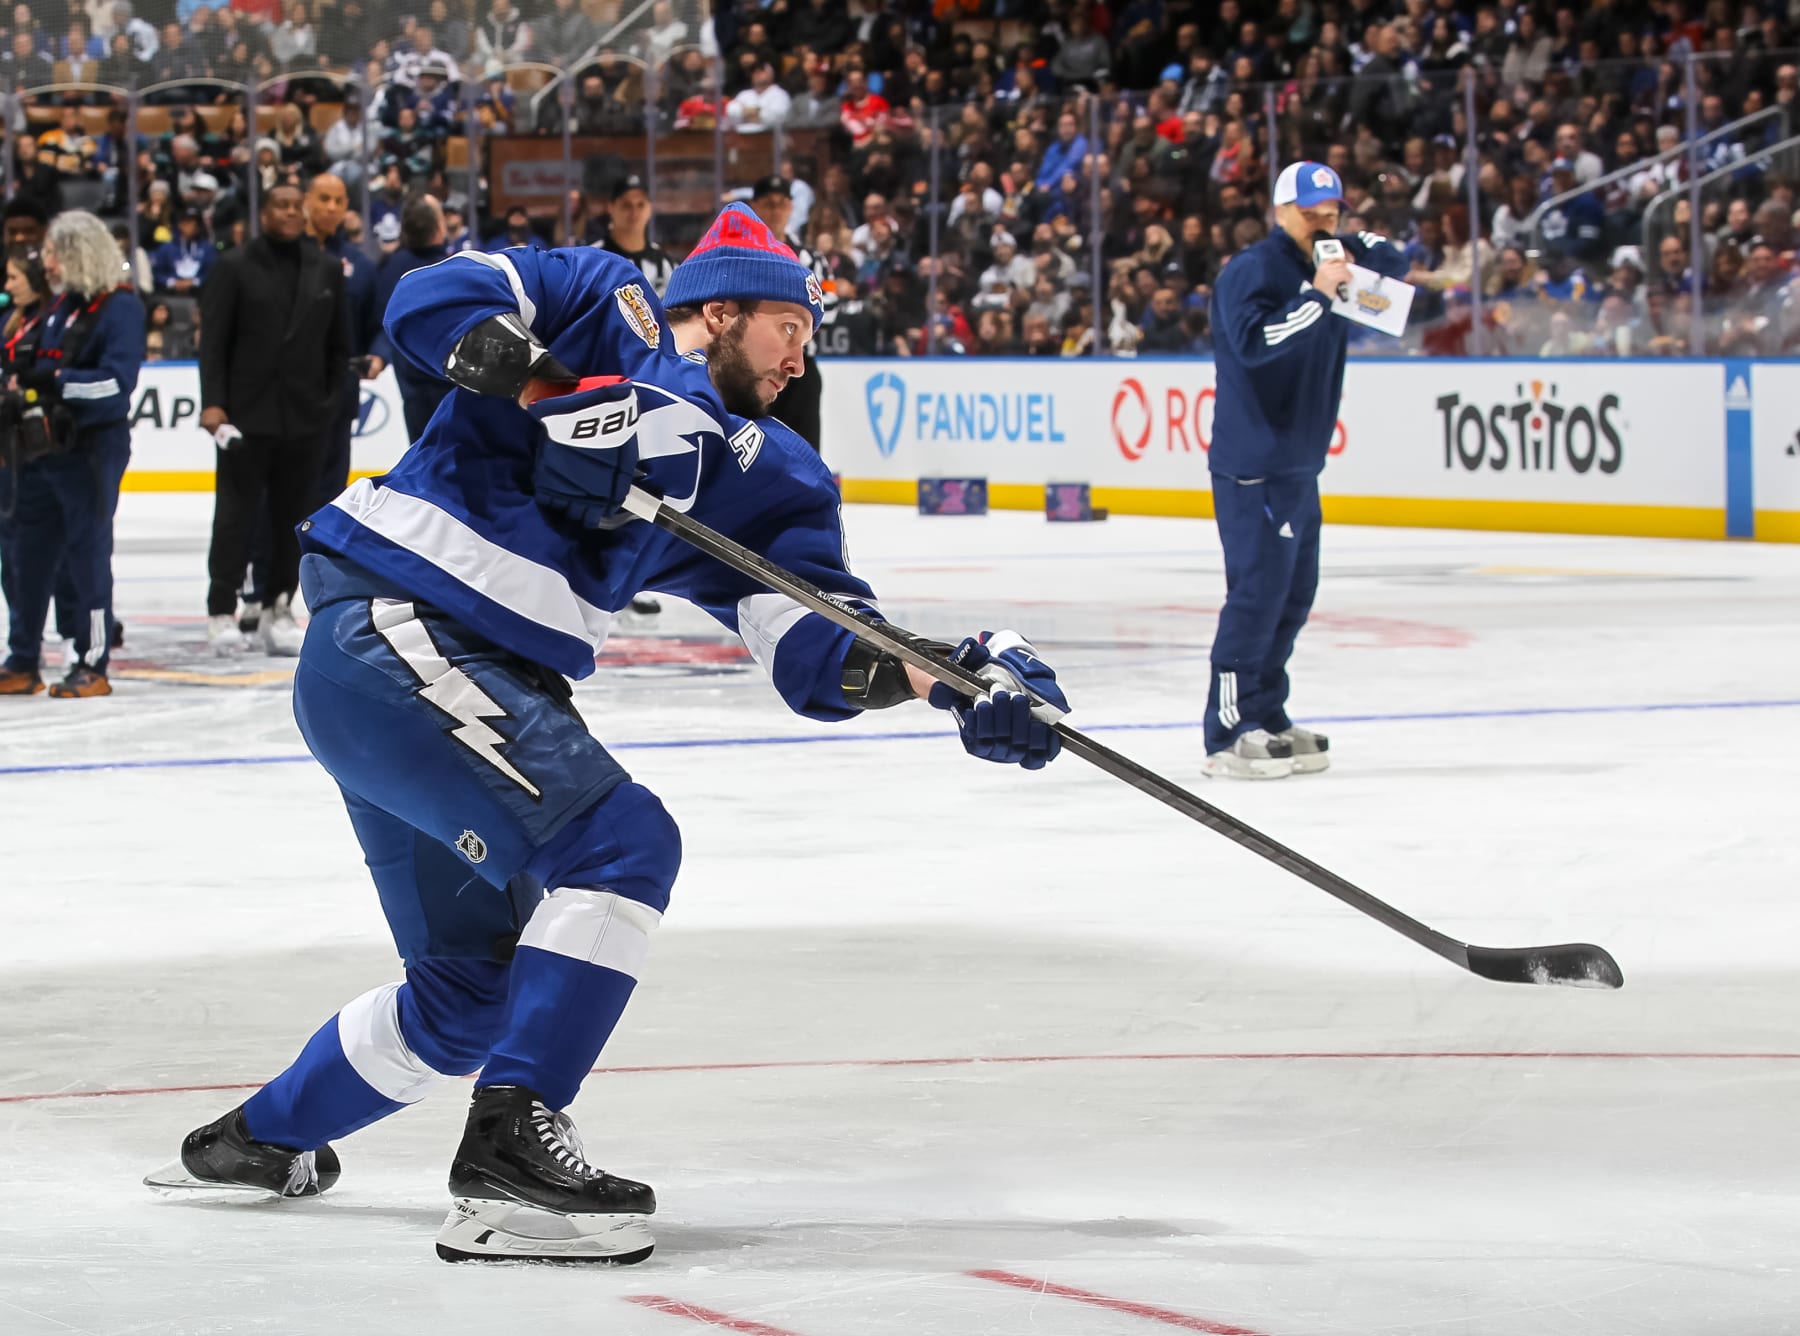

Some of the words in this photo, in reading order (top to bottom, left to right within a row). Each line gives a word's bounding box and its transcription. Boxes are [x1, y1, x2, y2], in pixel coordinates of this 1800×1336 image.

[916, 393, 1065, 442] FANDUEL
[728, 420, 765, 473] A
[816, 590, 860, 617] KUCHEROV
